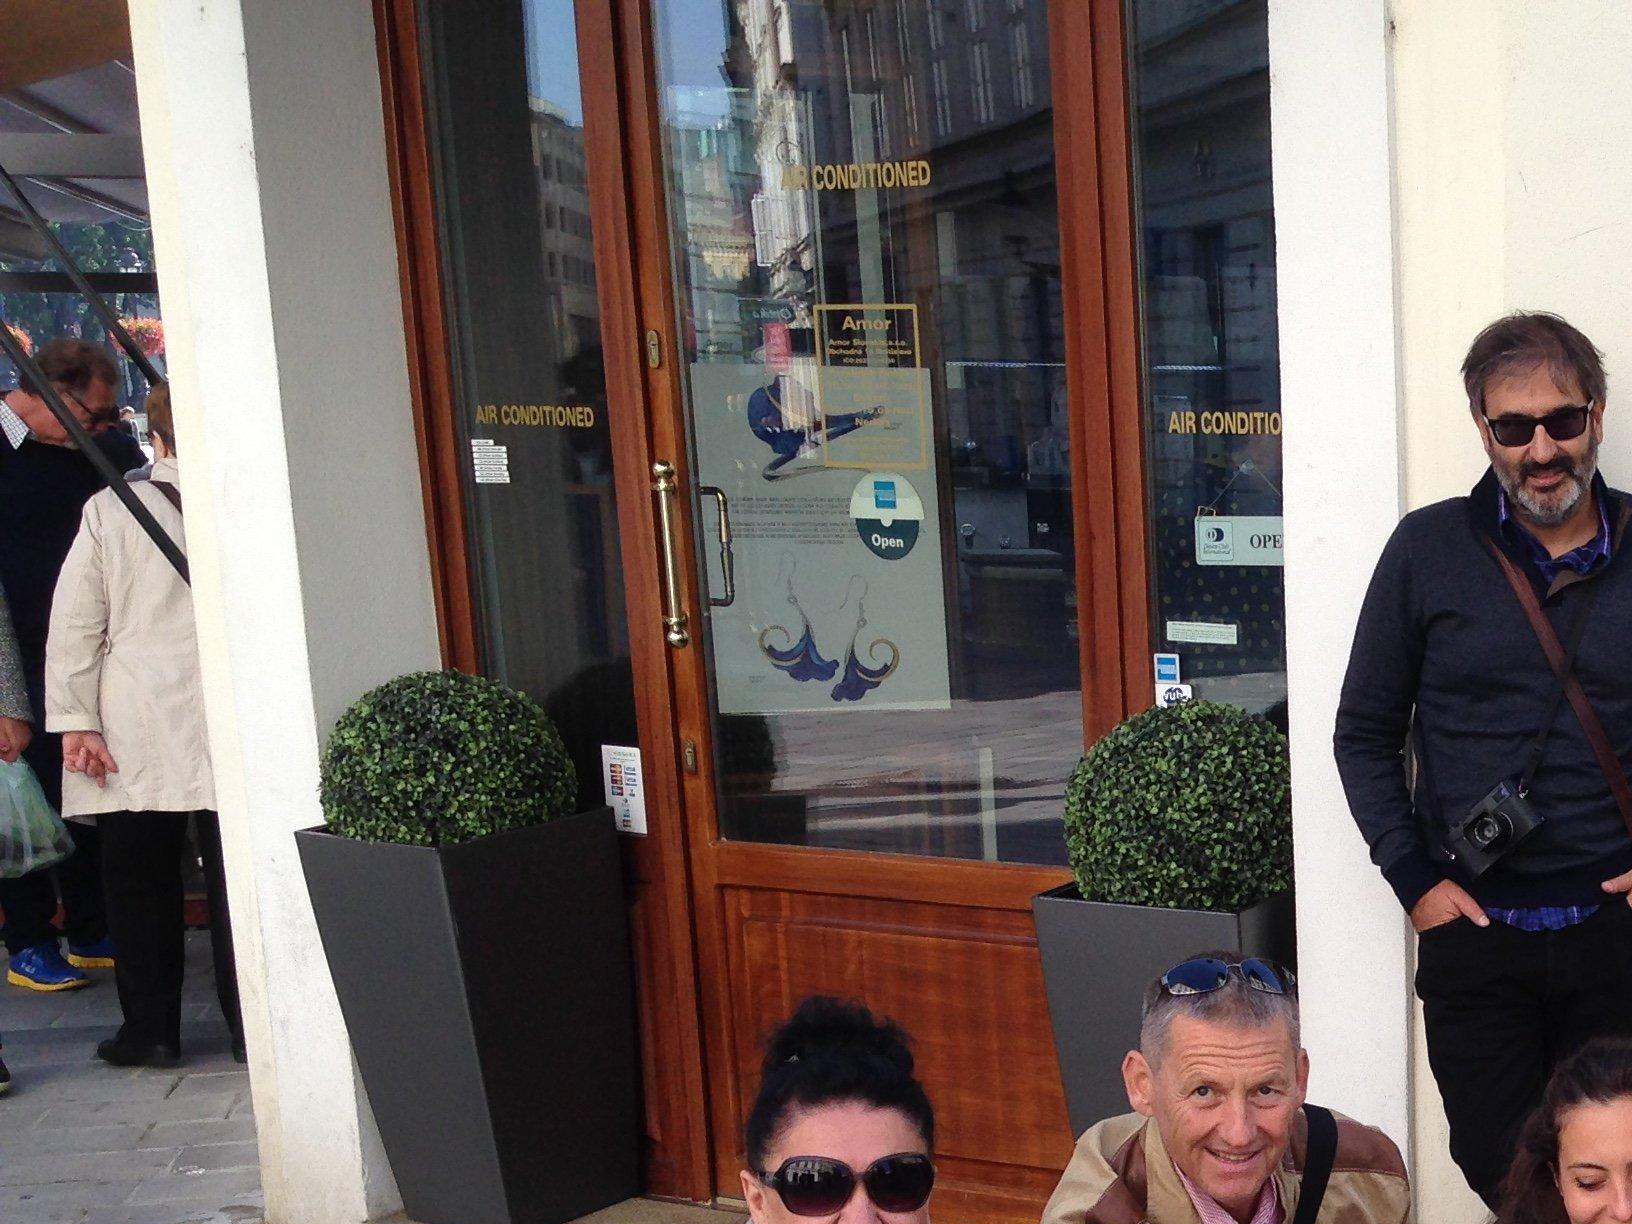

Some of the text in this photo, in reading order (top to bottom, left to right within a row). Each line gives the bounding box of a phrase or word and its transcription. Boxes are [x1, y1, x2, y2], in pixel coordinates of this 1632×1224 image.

[781, 160, 931, 190] AIR CONDITIONED
[842, 316, 892, 331] Amor
[475, 405, 595, 427] AIR CONDITIONED
[1168, 411, 1281, 435] AIR CONDITIO
[871, 533, 904, 549] Open
[1249, 533, 1283, 549] OPE
